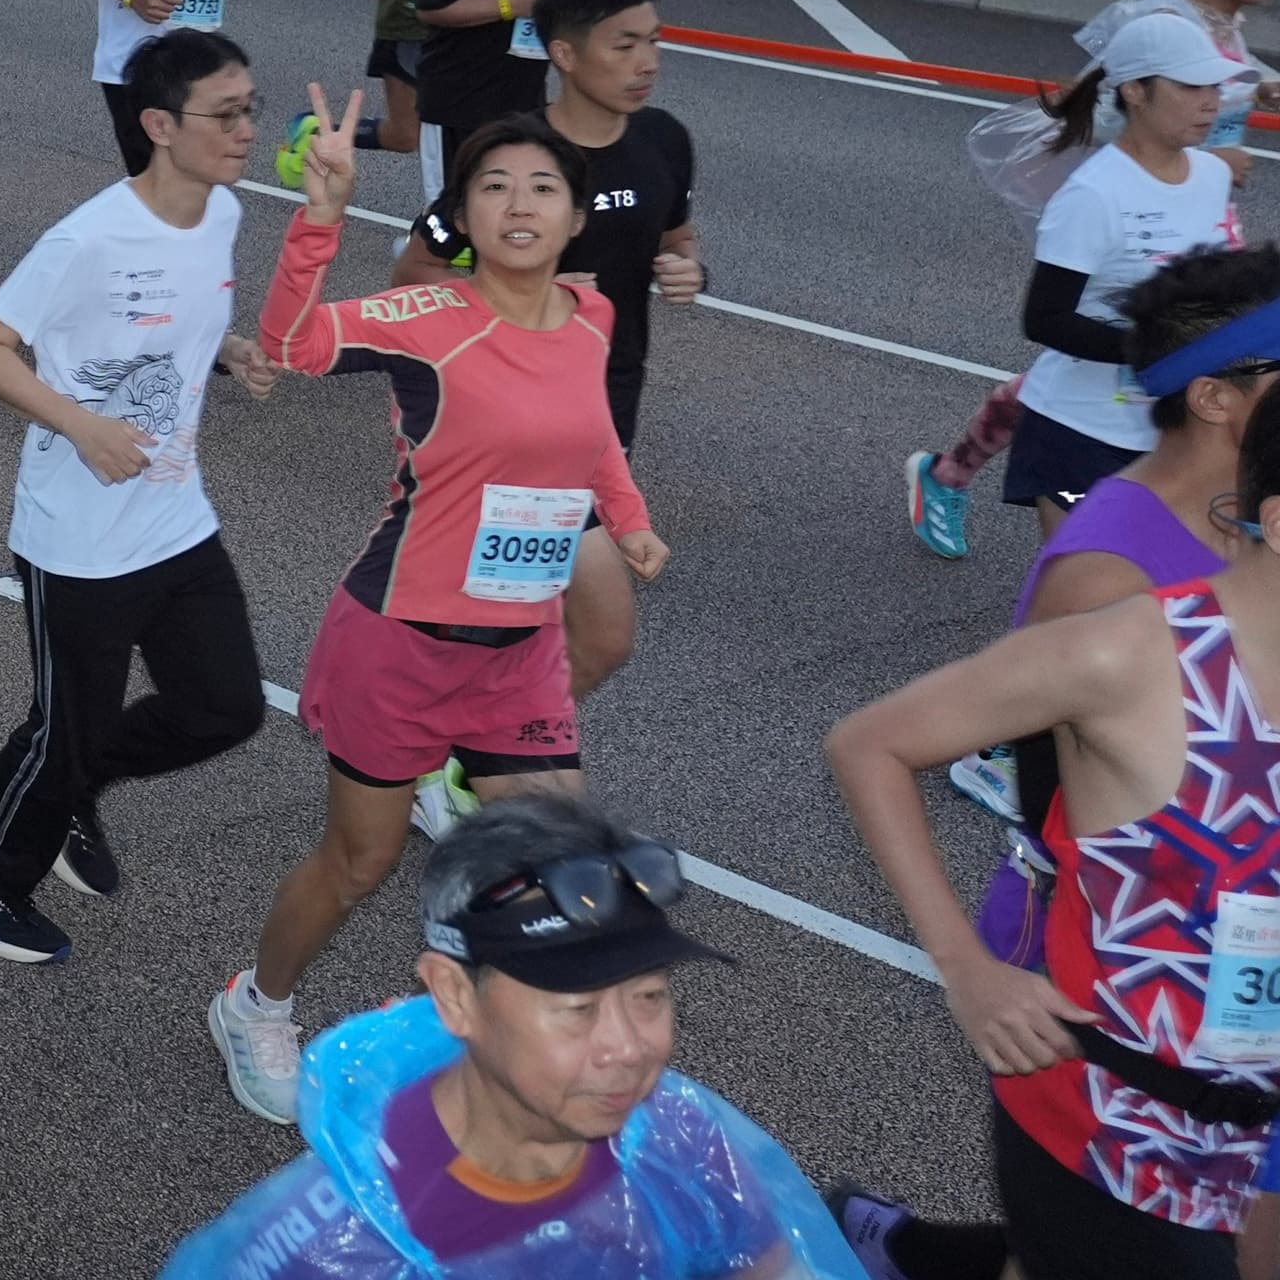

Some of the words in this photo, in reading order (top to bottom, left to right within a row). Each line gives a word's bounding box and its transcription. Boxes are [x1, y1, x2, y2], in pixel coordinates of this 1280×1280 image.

[610, 189, 636, 209] T8
[360, 285, 471, 323] ADIZERO
[480, 534, 572, 564] 30998
